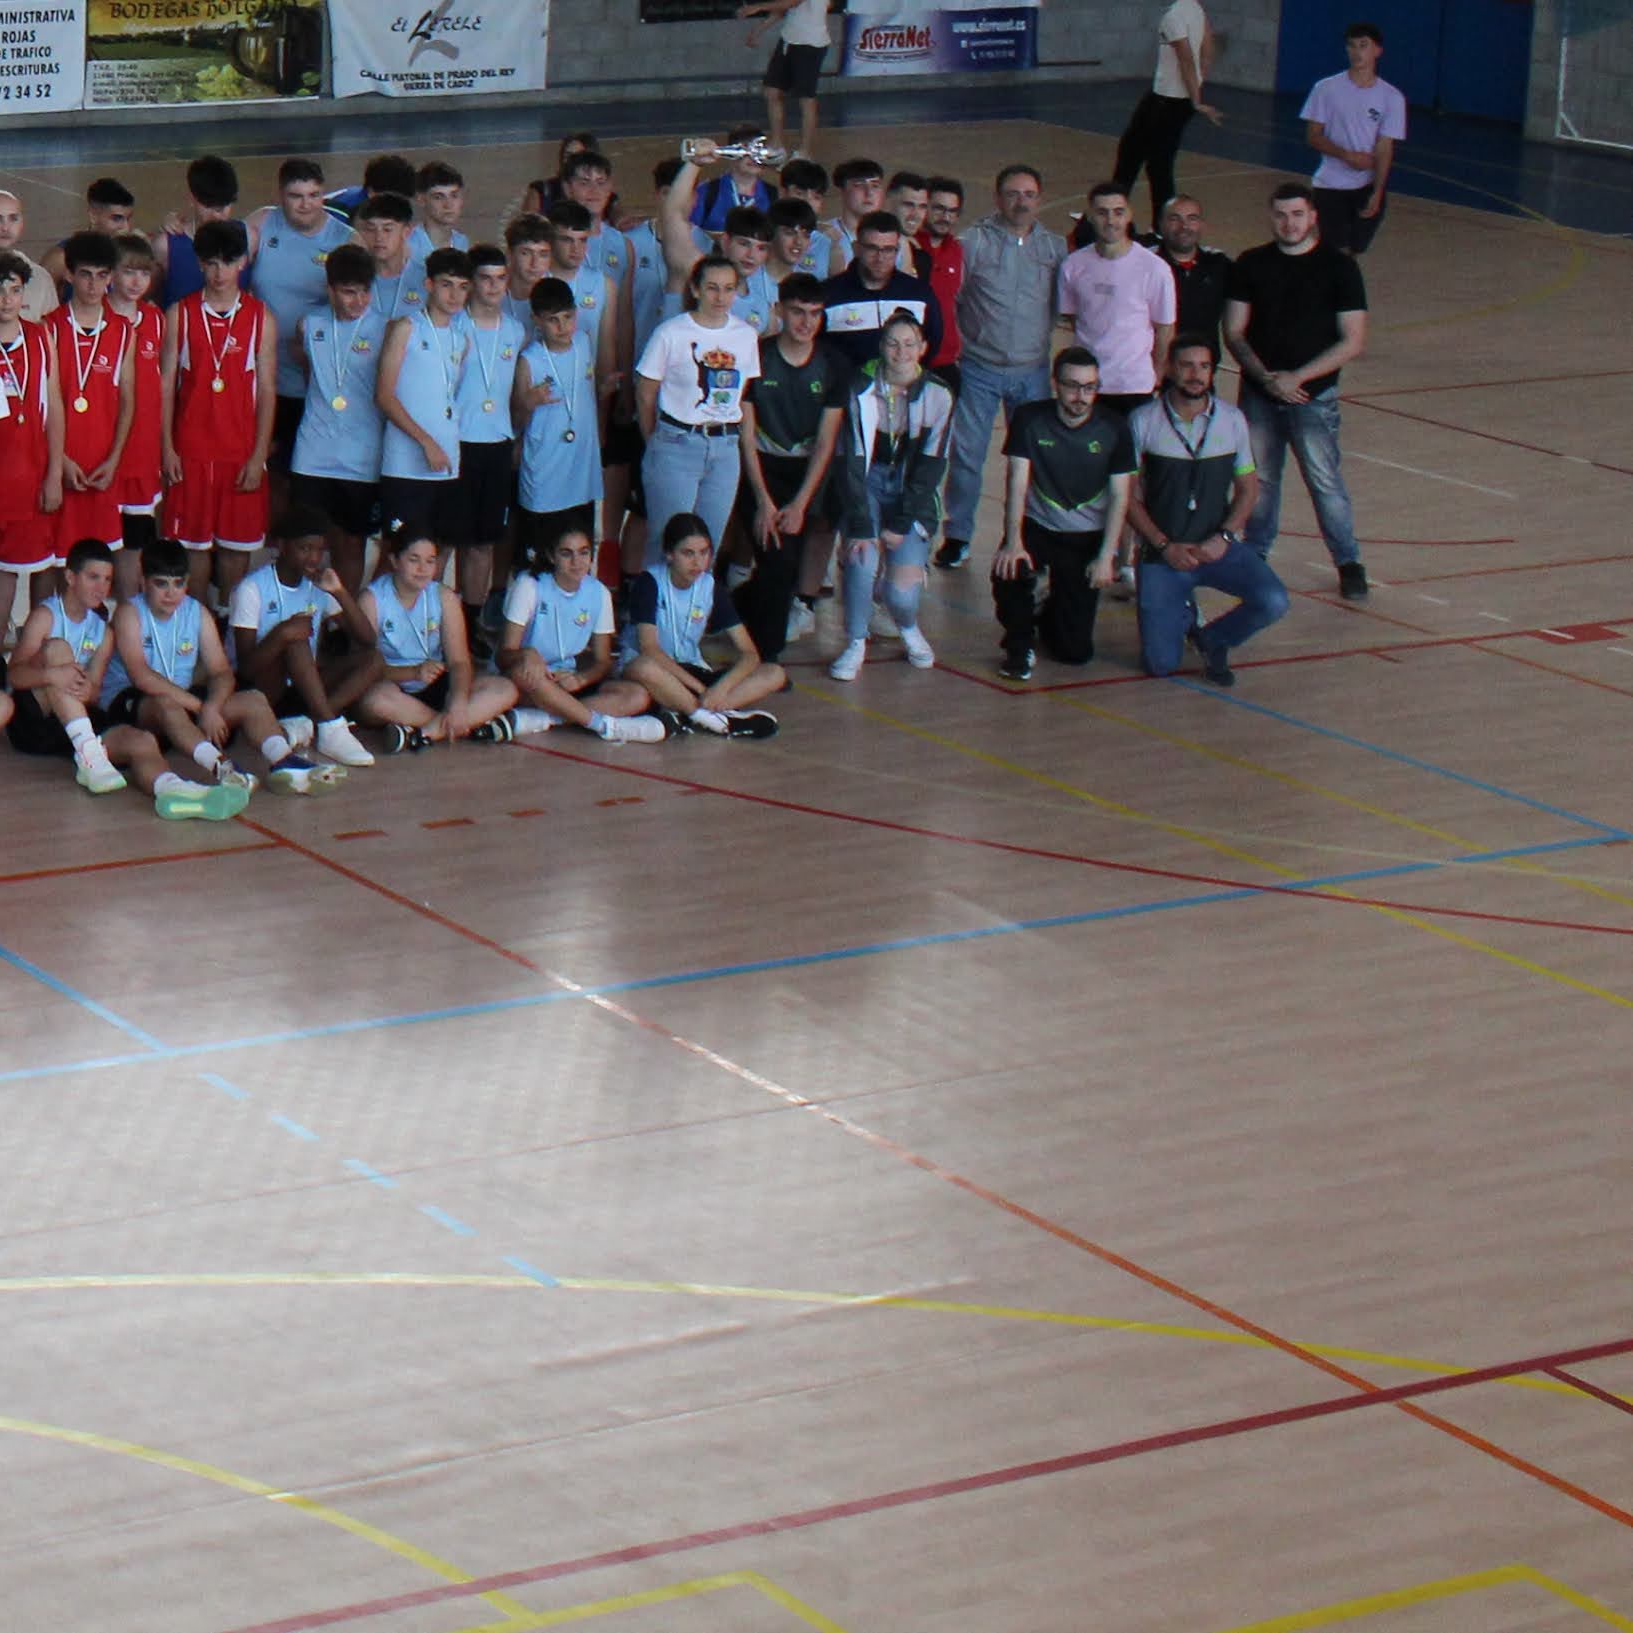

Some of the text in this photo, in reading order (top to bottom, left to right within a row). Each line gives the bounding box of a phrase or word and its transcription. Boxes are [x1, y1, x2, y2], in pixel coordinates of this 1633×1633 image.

[110, 1, 201, 21] BODEGAS
[2, 30, 36, 44] ROJAS
[860, 25, 931, 49] SierraNet
[10, 45, 52, 60] TRAFICO
[0, 63, 61, 78] ESCRITURAS
[360, 68, 516, 82] CALLE DE PRADO DEL REY
[15, 84, 33, 100] 34
[35, 84, 52, 99] 52
